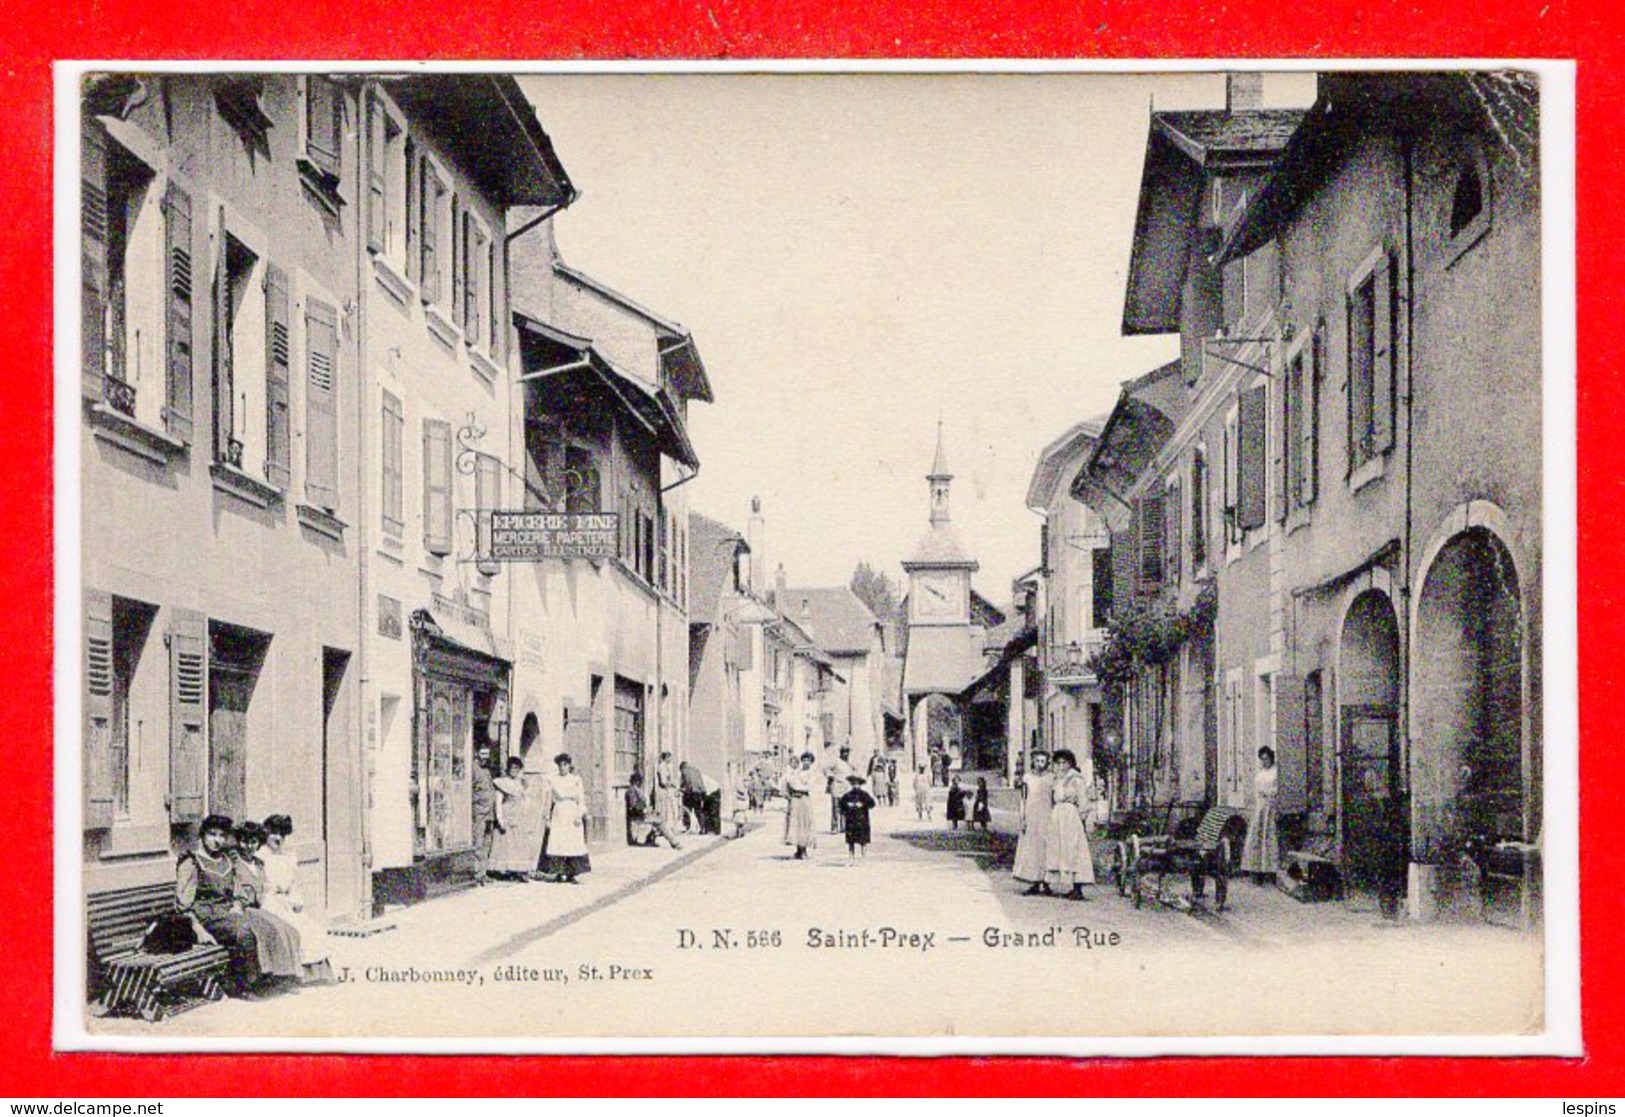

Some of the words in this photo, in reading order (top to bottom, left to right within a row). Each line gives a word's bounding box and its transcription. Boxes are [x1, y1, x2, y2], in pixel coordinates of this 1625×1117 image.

[493, 515, 567, 530] EPICERIE
[575, 515, 617, 530] FINE
[493, 531, 551, 544] MERCERIE
[556, 531, 616, 544] PAPETERIE
[493, 545, 539, 556] CARTES
